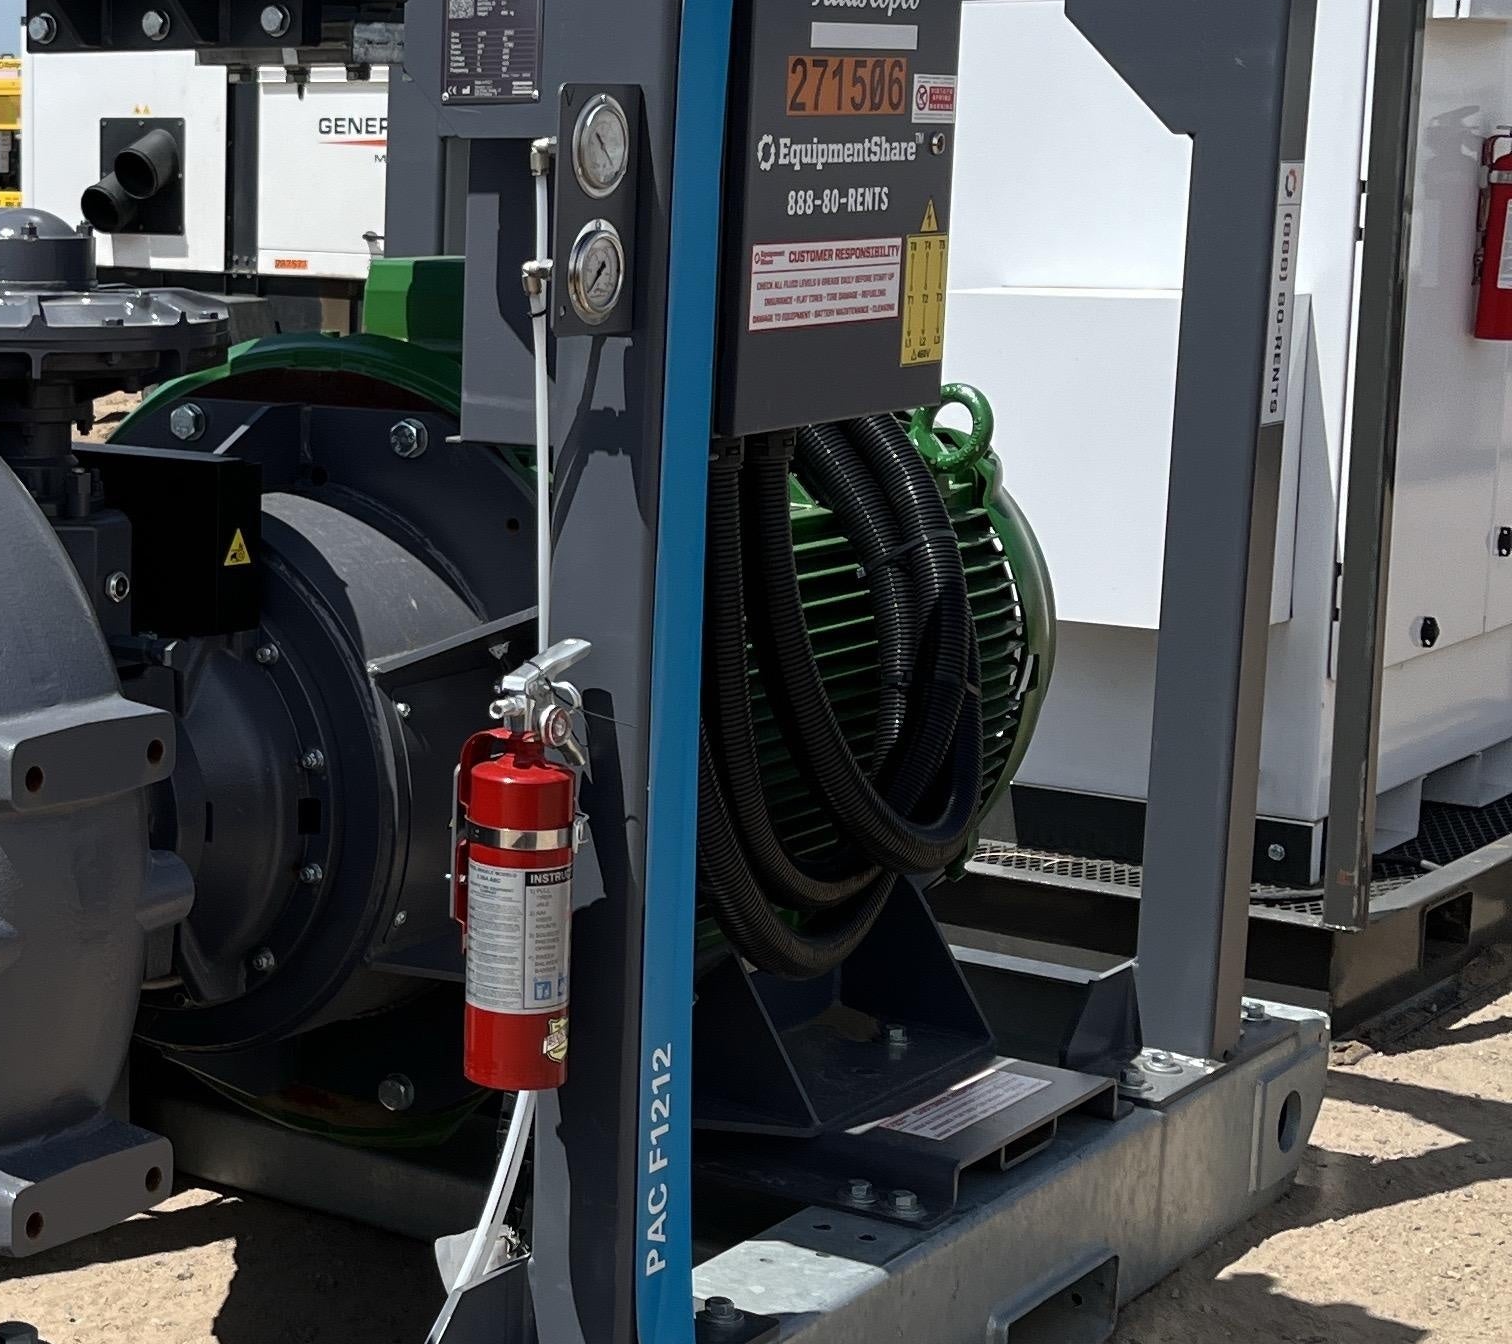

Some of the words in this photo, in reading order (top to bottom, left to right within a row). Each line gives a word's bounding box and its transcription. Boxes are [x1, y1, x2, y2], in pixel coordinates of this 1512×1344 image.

[789, 57, 904, 112] 271506
[787, 186, 889, 215] 888-80-RENTS
[789, 249, 834, 263] CUSTOMER
[835, 244, 900, 260] RESPONSIBILITY
[648, 1042, 672, 1174] F1212
[645, 1182, 668, 1277] PAC
